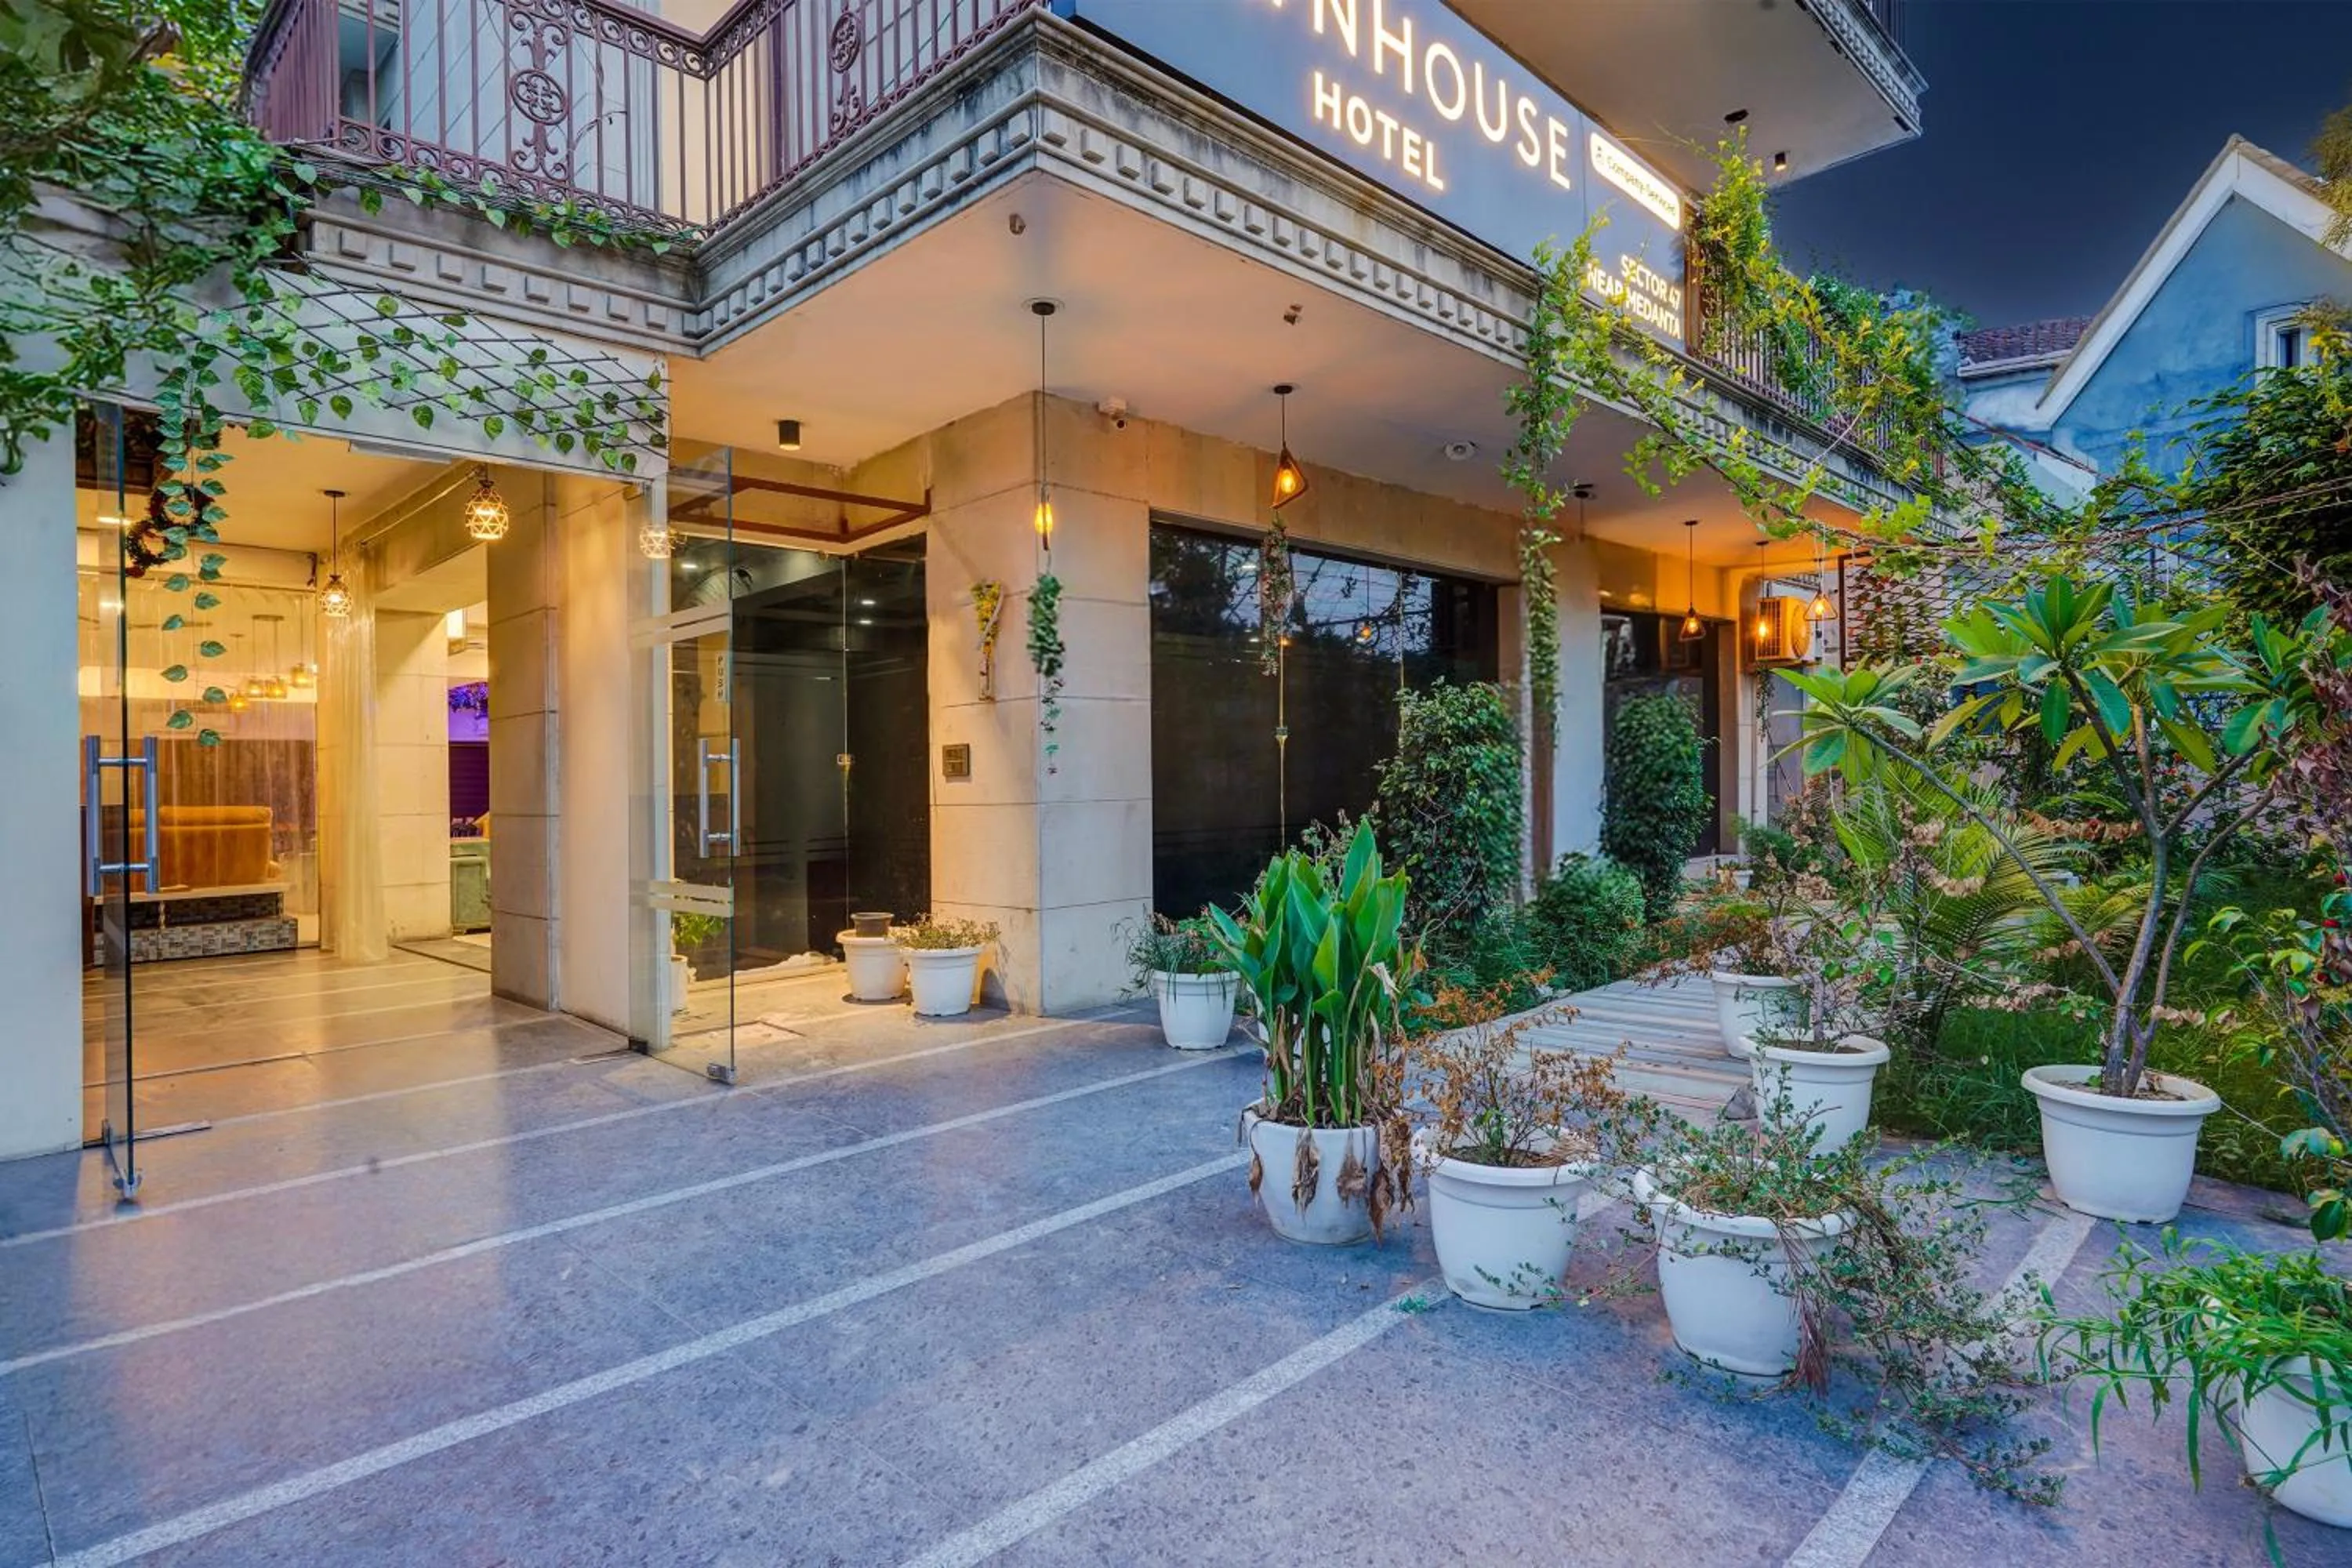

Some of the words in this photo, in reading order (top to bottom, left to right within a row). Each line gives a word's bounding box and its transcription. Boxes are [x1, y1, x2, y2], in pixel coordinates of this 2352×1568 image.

[1272, 0, 1570, 189] NHOUSE
[1314, 71, 1444, 190] HOTEL
[1621, 254, 1668, 302] SECTOR
[1625, 286, 1681, 339] MEDANTA
